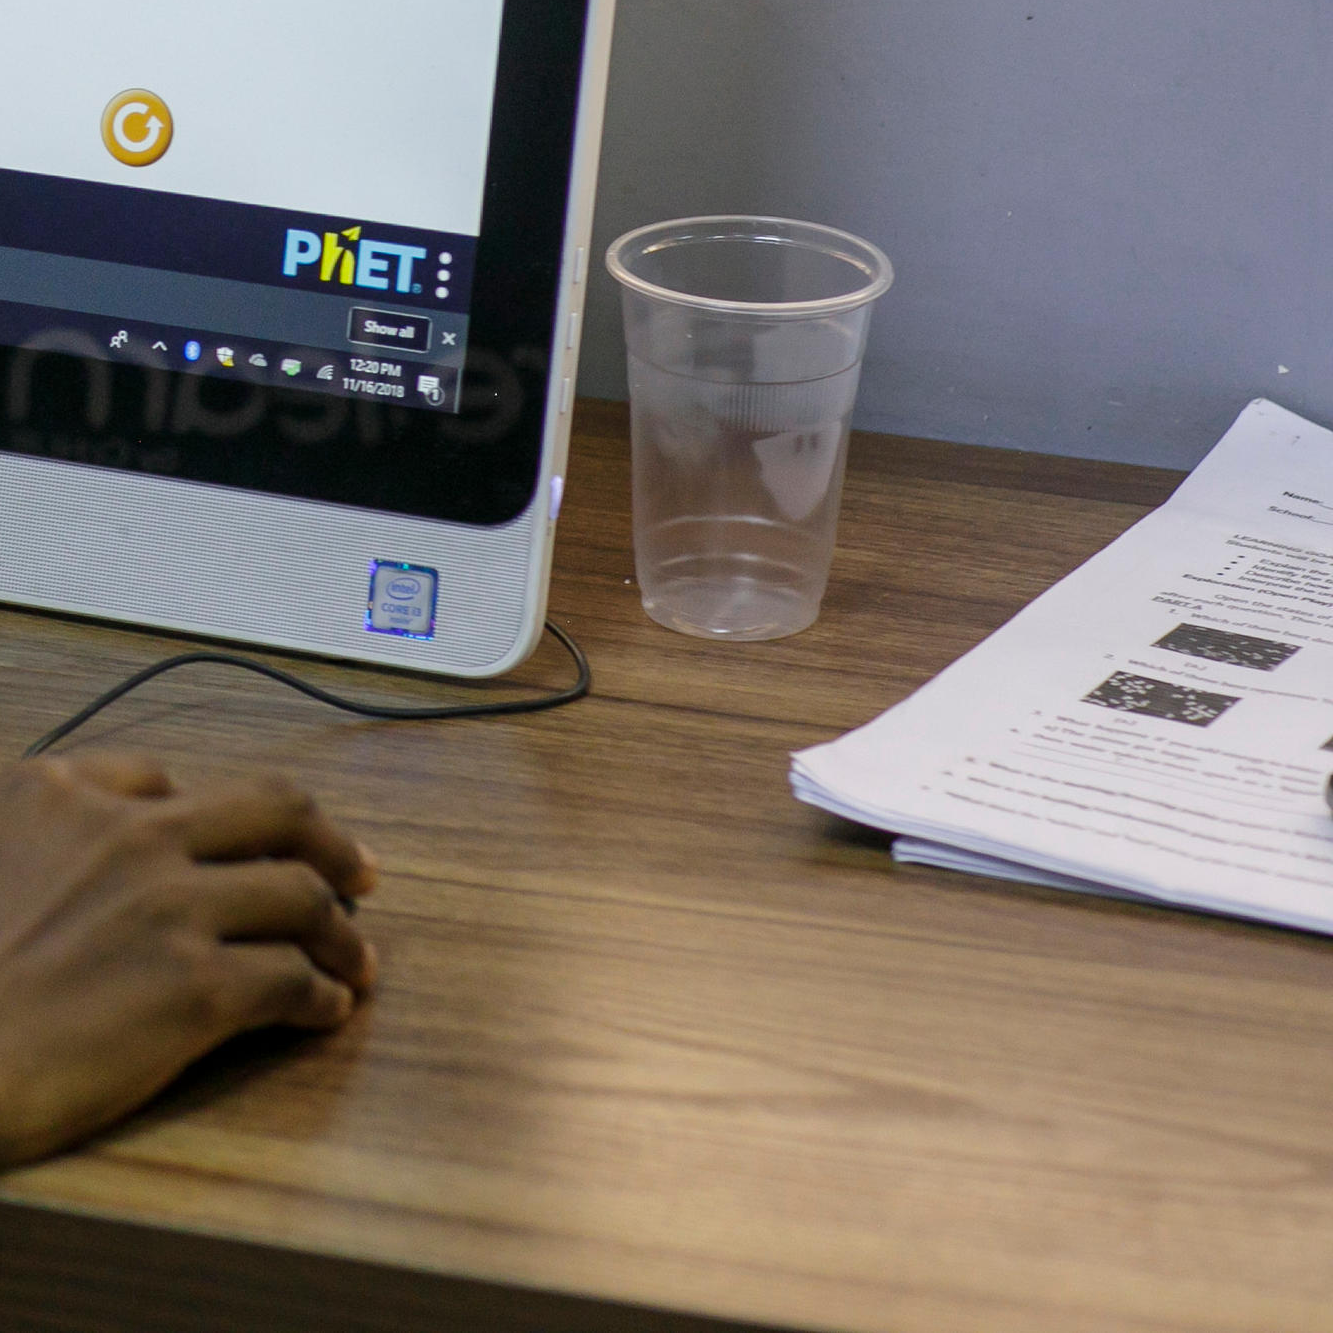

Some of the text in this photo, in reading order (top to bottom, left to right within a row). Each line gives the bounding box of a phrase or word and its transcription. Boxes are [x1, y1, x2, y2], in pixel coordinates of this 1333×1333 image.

[364, 320, 415, 339] Show all
[350, 358, 402, 377] 12:20 PM
[342, 377, 405, 398] 11/16/2018
